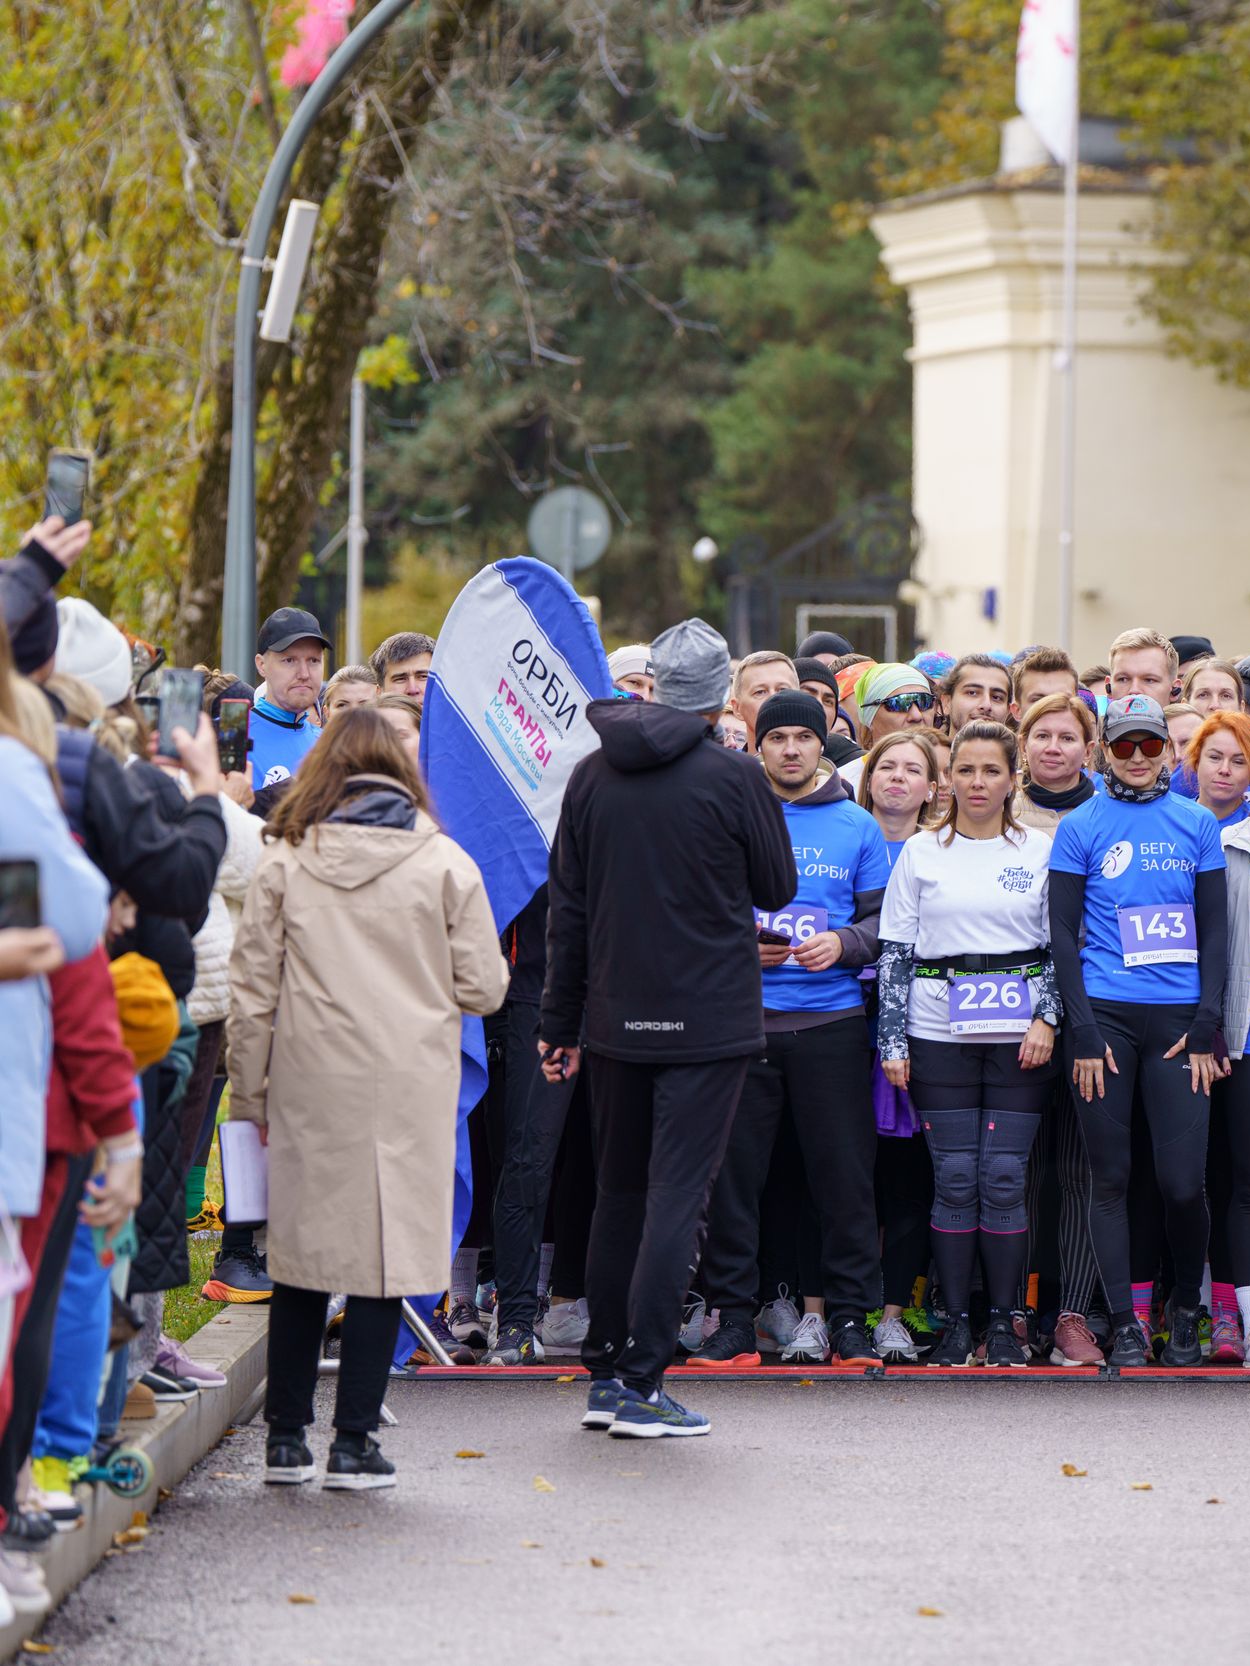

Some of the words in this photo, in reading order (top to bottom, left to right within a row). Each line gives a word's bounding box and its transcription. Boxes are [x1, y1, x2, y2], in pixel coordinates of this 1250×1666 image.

[512, 639, 578, 731] ОРБИ
[497, 677, 552, 768] ГРАНТЫ
[489, 694, 511, 733] Мэра
[510, 730, 543, 782] Москвы
[792, 846, 823, 859] ЕГУ
[1140, 842, 1176, 855] БЕГУ
[804, 863, 849, 881] ОРБИ
[1141, 859, 1159, 871] ЗА
[1161, 858, 1196, 873] ОРБИ
[757, 912, 816, 942] 166
[1129, 912, 1187, 941] 143
[956, 981, 1022, 1010] 226
[624, 1020, 684, 1031] NORDSKI
